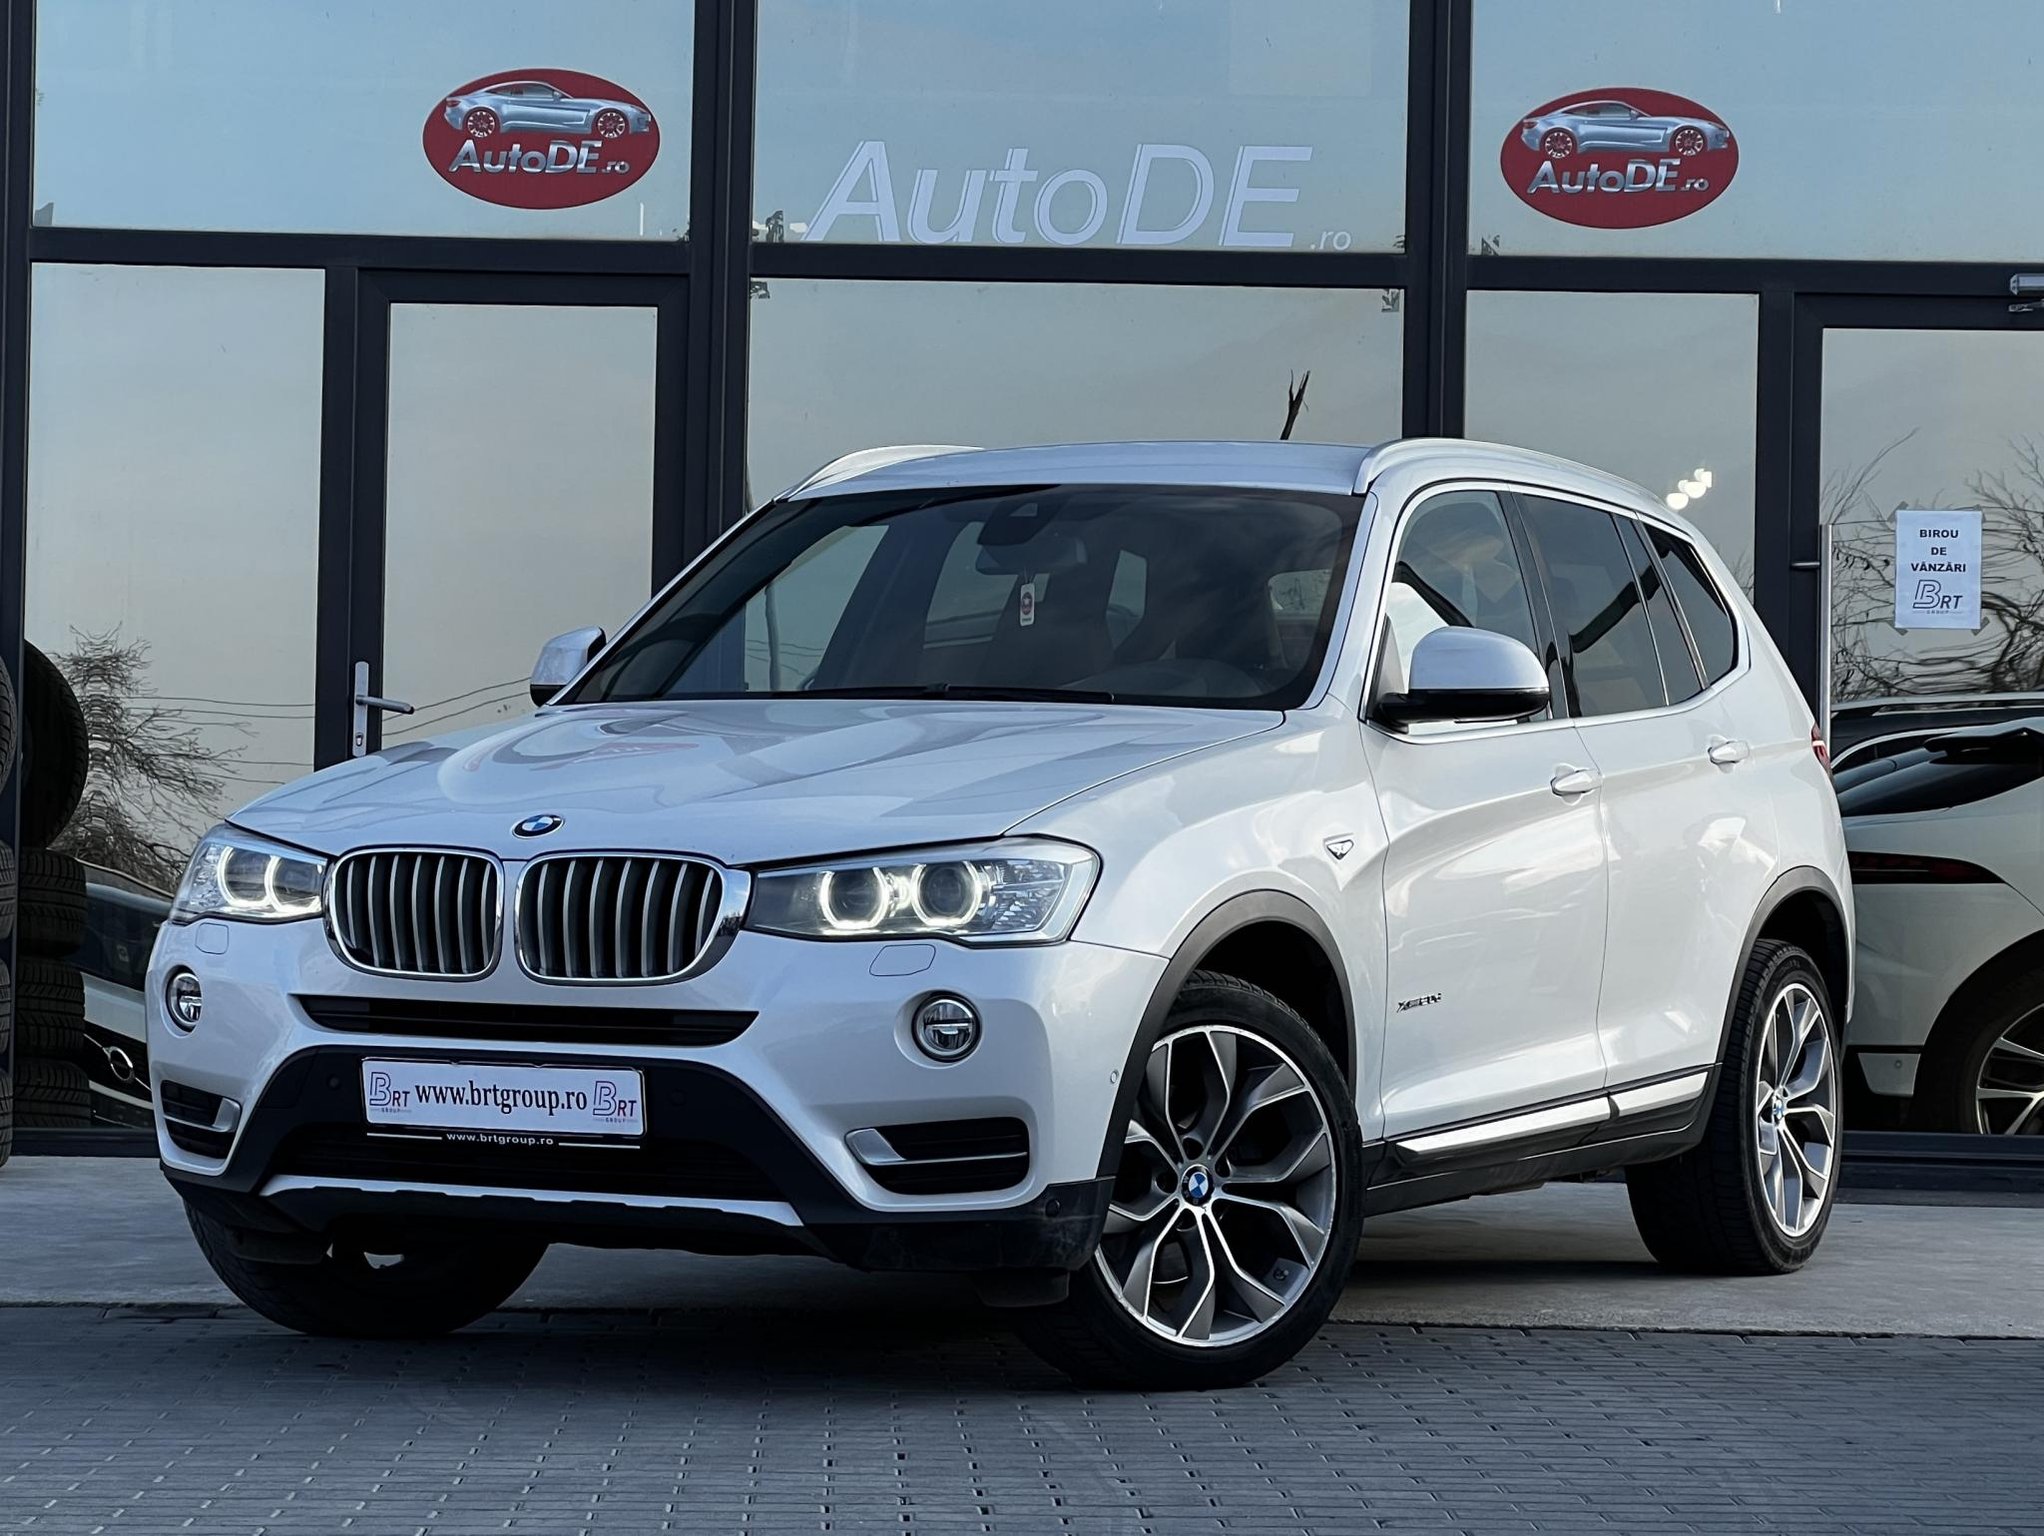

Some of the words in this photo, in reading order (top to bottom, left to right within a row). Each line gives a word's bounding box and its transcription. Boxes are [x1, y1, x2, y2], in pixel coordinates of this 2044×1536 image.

[1919, 529, 1959, 539] BIROU
[1931, 547, 1947, 556] DE
[414, 1080, 588, 1116] www.brtgroup.ro
[446, 1133, 554, 1146] www.brtgroup.ro
